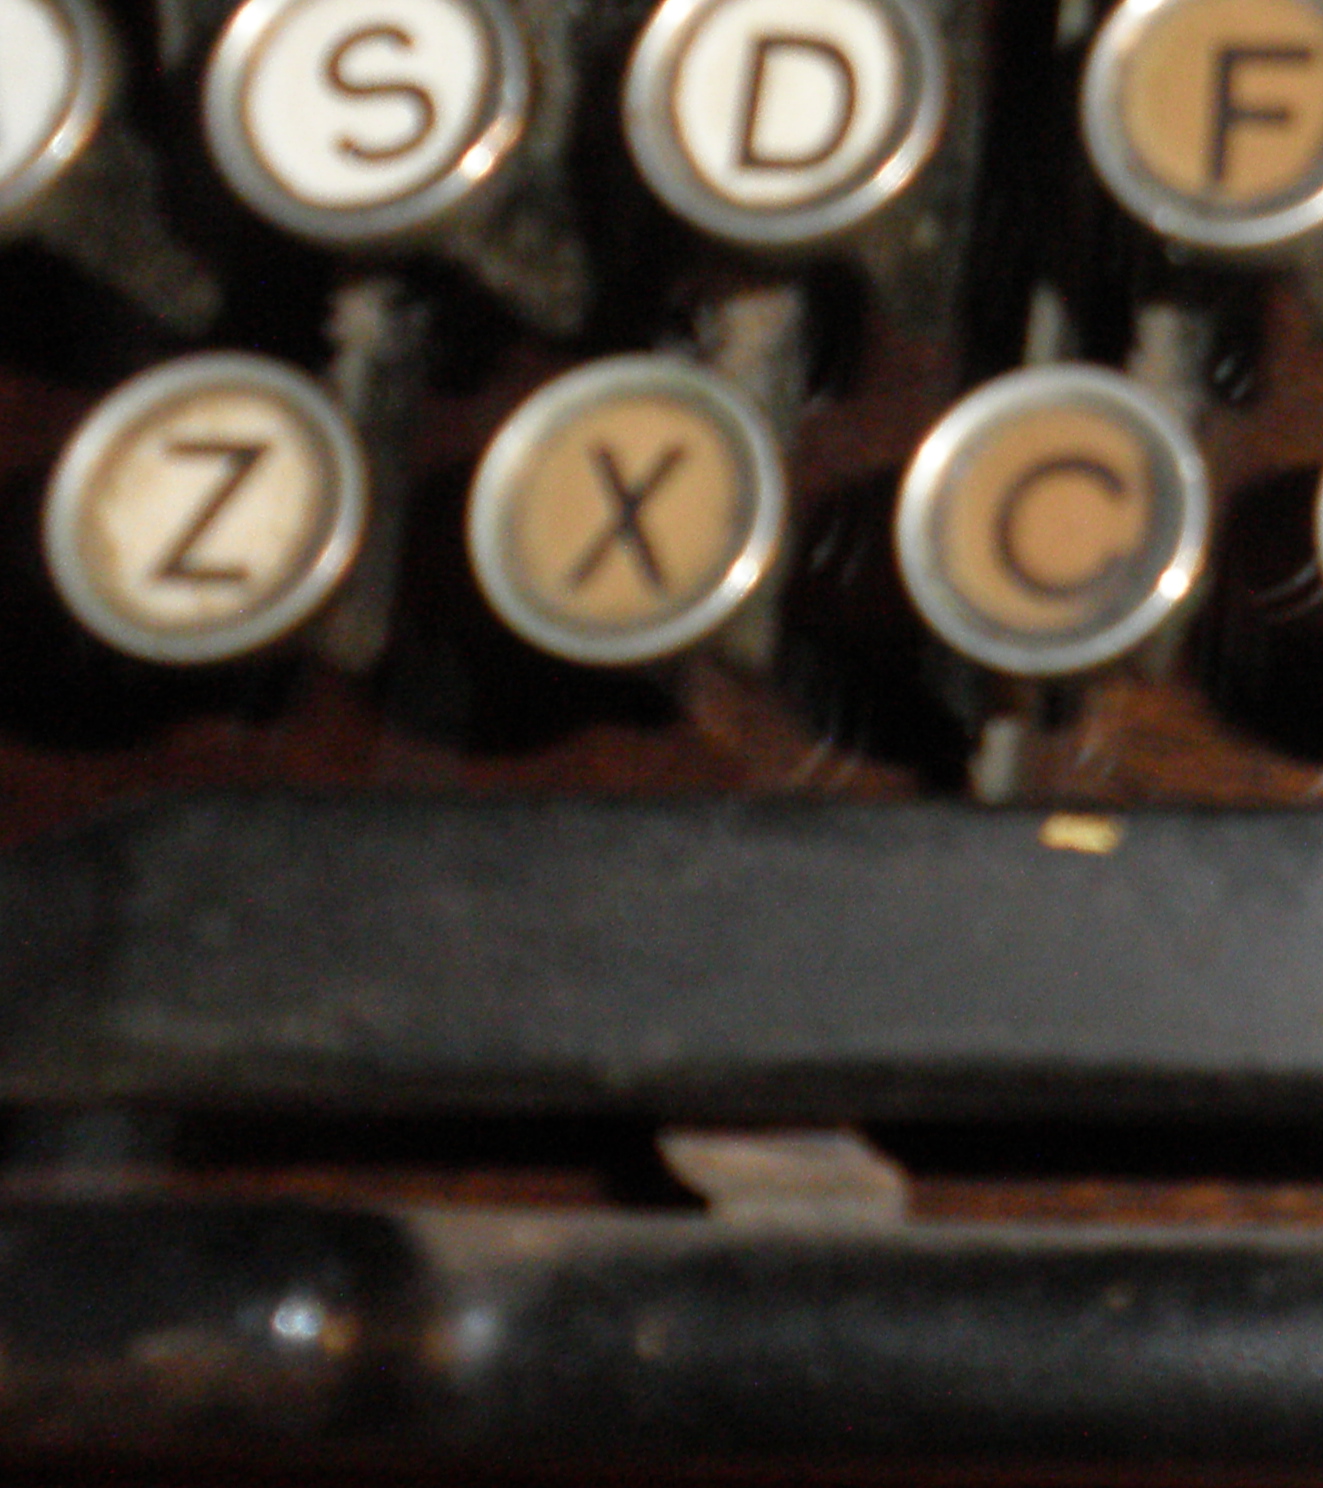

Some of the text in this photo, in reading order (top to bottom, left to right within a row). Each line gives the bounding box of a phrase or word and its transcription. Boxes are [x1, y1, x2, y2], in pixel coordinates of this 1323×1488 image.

[323, 24, 437, 166] S
[732, 32, 858, 172] D
[1208, 47, 1312, 185] F
[150, 440, 272, 586] Z
[565, 443, 690, 594] X
[995, 456, 1130, 599] C
